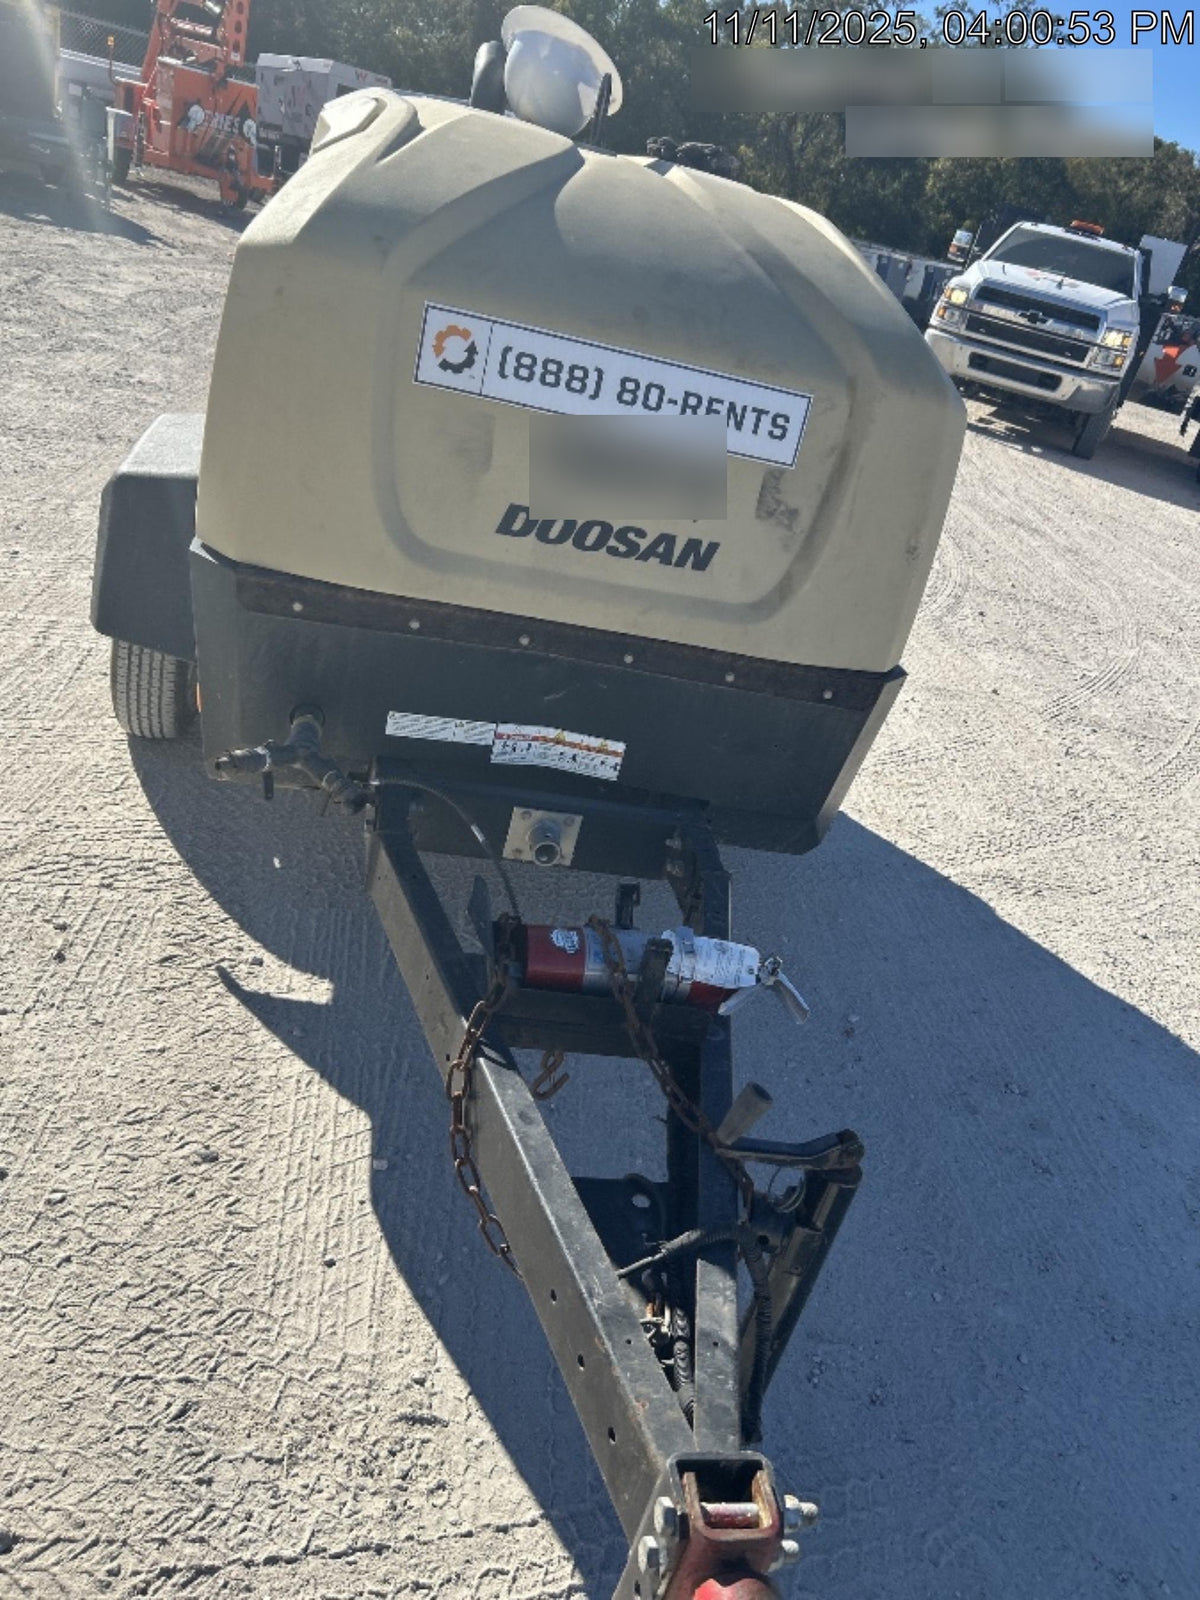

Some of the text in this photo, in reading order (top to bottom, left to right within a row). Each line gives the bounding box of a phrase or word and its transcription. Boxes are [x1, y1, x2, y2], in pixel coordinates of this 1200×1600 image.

[498, 346, 790, 441] (888) 80-RENTS
[496, 503, 720, 571] DOOSAN
